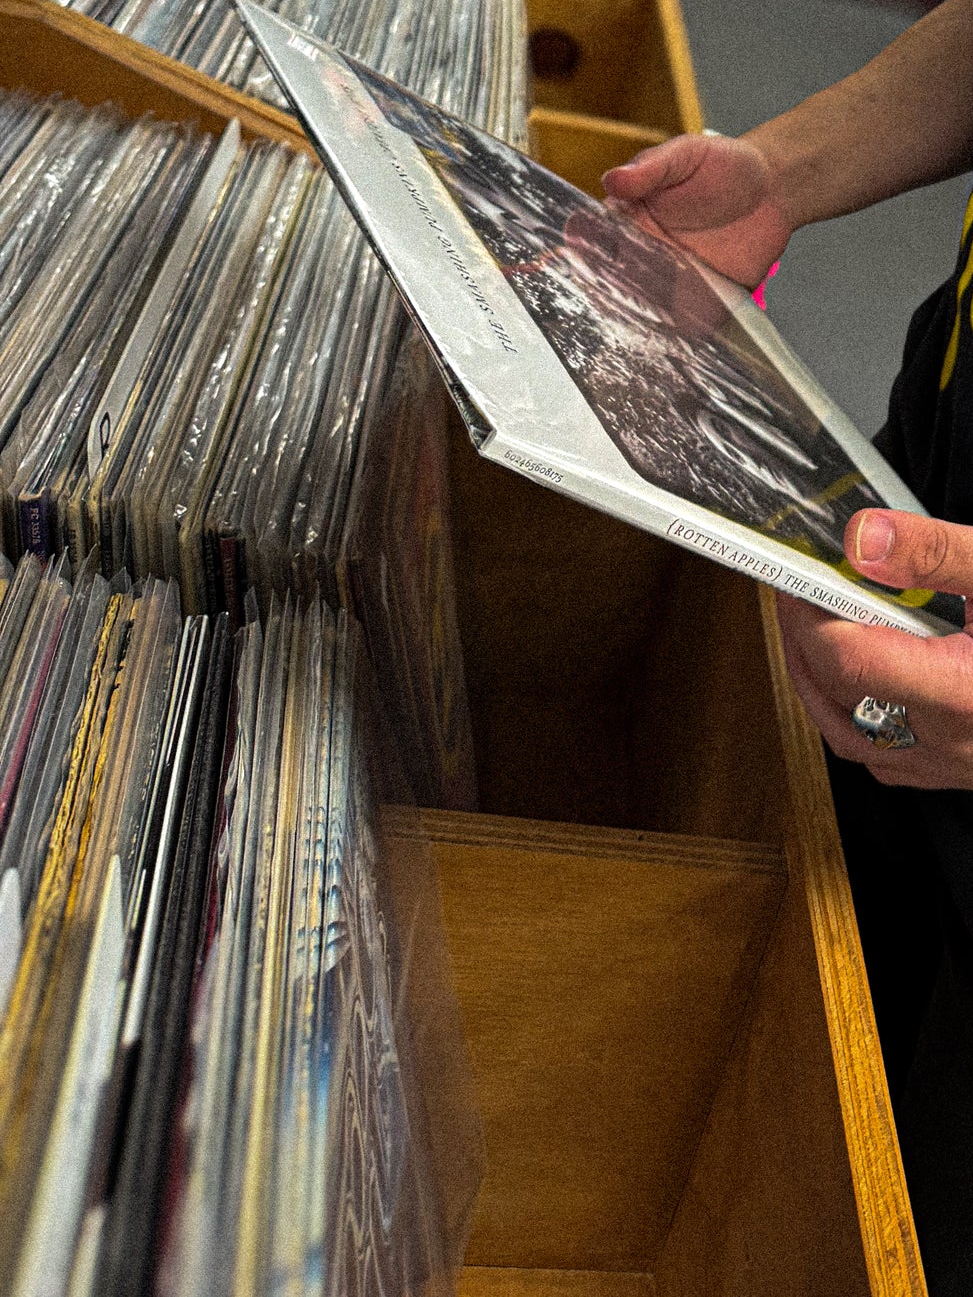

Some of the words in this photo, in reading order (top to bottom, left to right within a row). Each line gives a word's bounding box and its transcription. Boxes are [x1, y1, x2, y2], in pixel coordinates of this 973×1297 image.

[437, 235, 495, 316] SMASHING
[488, 319, 519, 353] THE
[503, 449, 565, 483] 602465608175
[784, 573, 809, 594] THE
[810, 587, 869, 620] SMASHING
